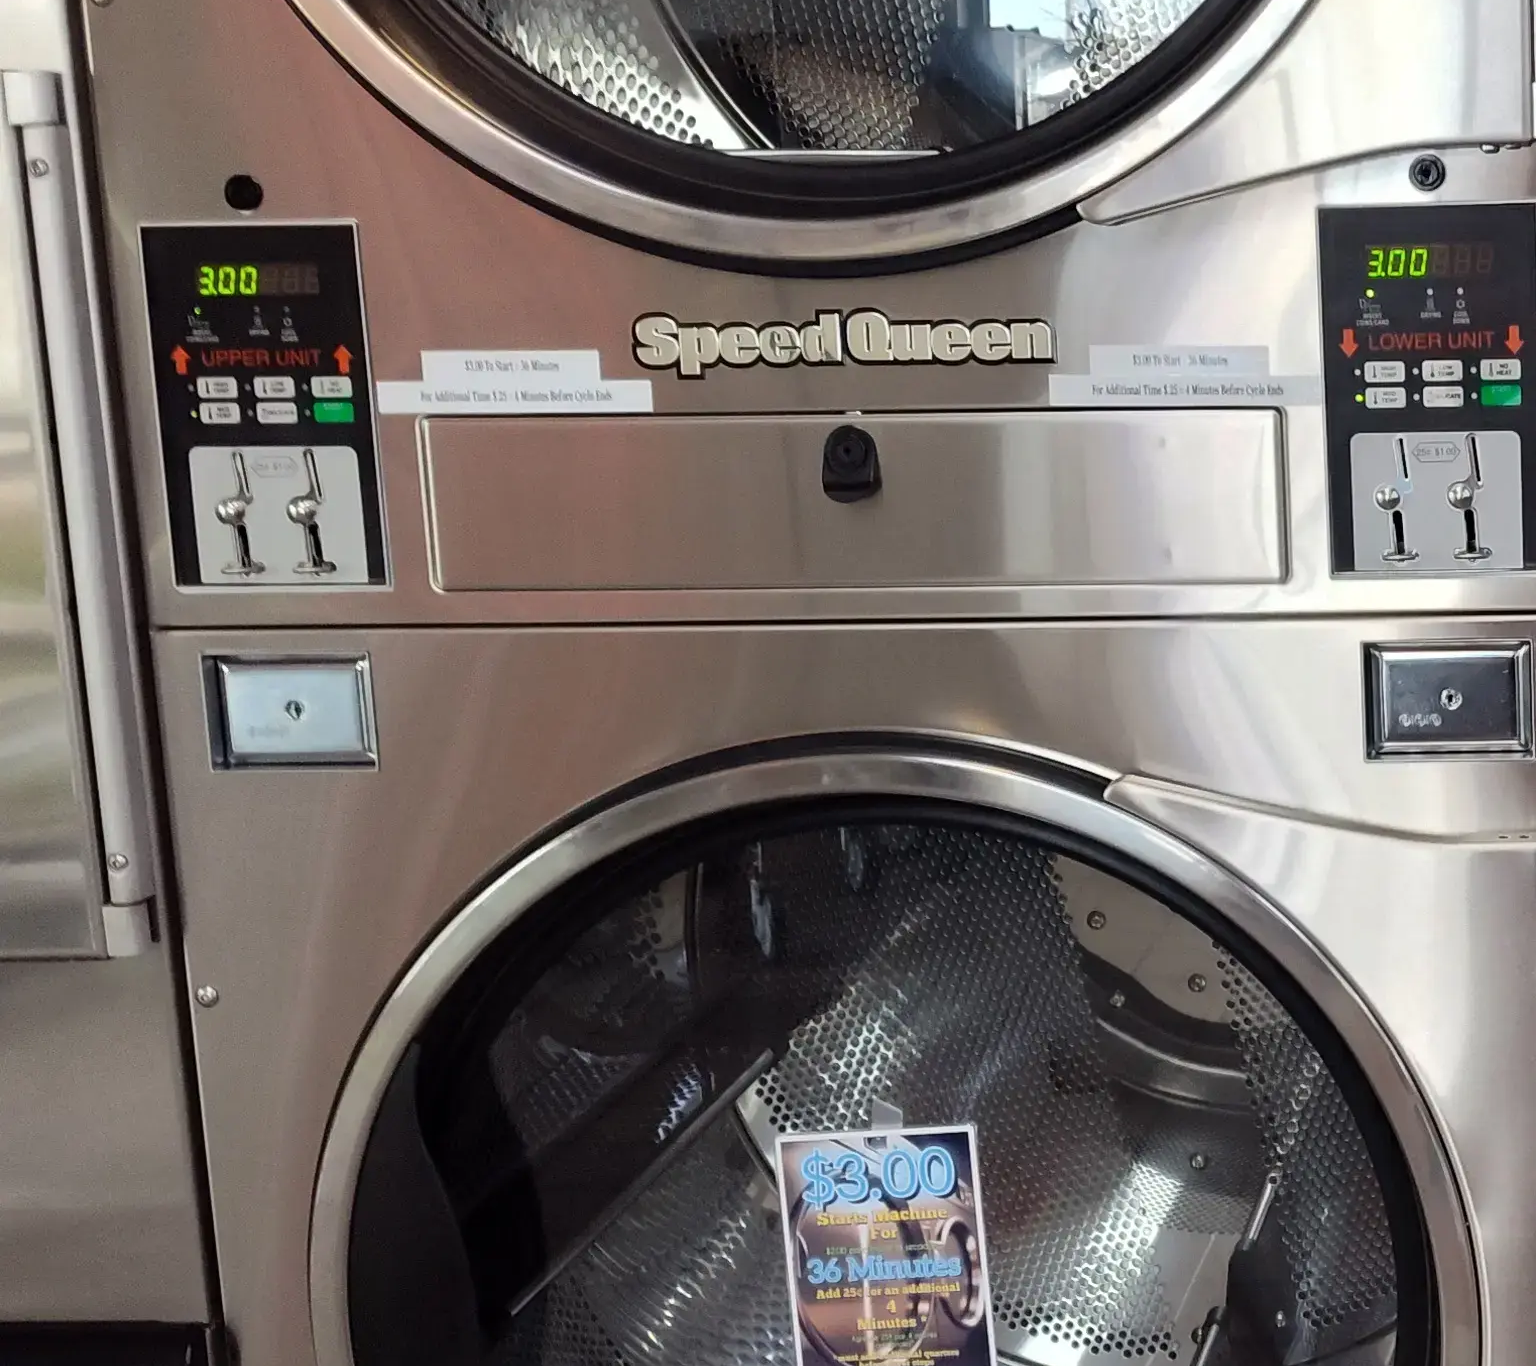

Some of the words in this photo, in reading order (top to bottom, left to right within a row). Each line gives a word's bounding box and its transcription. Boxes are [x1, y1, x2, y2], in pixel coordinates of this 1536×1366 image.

[1368, 247, 1428, 278] 3.00
[199, 265, 258, 296] 3.00
[633, 309, 846, 380] Speed
[846, 307, 1057, 366] Queen
[1368, 332, 1442, 351] LOWER
[1448, 330, 1495, 349] UNIT
[202, 349, 269, 367] UPPER
[276, 348, 321, 366] UNIT
[1199, 355, 1228, 365] Minutes
[1092, 385, 1103, 395] For
[1106, 385, 1141, 395] Additional
[1144, 385, 1161, 394] Time
[1191, 385, 1219, 394] Minutes
[1220, 384, 1244, 394] Before
[1246, 384, 1265, 396] Cycle
[1267, 384, 1284, 394] Ends
[801, 1146, 955, 1211] $3.00
[816, 1212, 868, 1227] Starts
[872, 1206, 948, 1223] Machine
[871, 1226, 898, 1240] For
[806, 1257, 843, 1284] 36
[845, 1254, 962, 1283] Minutes
[816, 1288, 841, 1300] Add
[884, 1286, 899, 1295] an
[900, 1282, 960, 1295] additional
[886, 1299, 896, 1313] 4
[857, 1317, 917, 1330] Minutes
[924, 1349, 960, 1360] quarters
